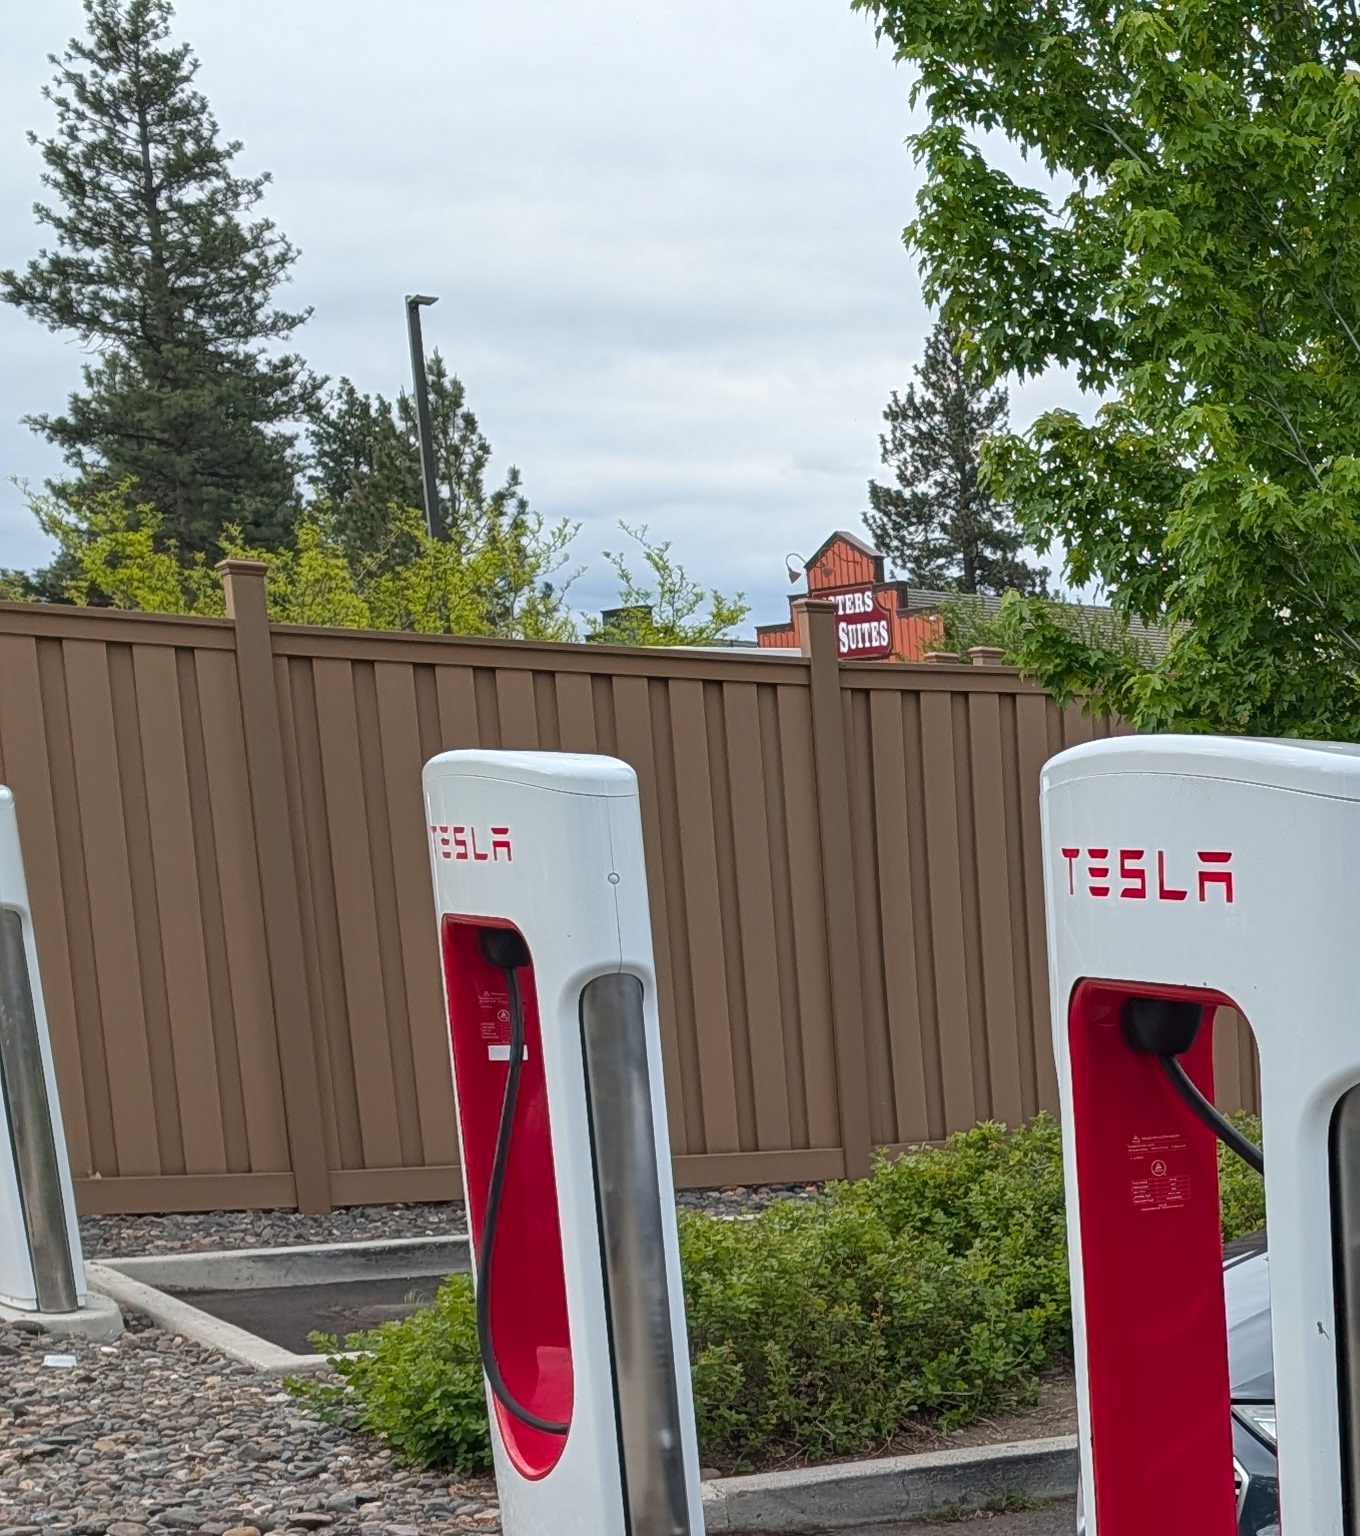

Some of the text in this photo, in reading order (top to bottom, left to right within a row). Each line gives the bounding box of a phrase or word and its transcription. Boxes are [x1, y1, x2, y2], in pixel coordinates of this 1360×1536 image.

[822, 590, 874, 616] TERS
[838, 620, 889, 653] SUITES
[430, 825, 513, 862] TESLA
[1061, 847, 1234, 904] TESLA
